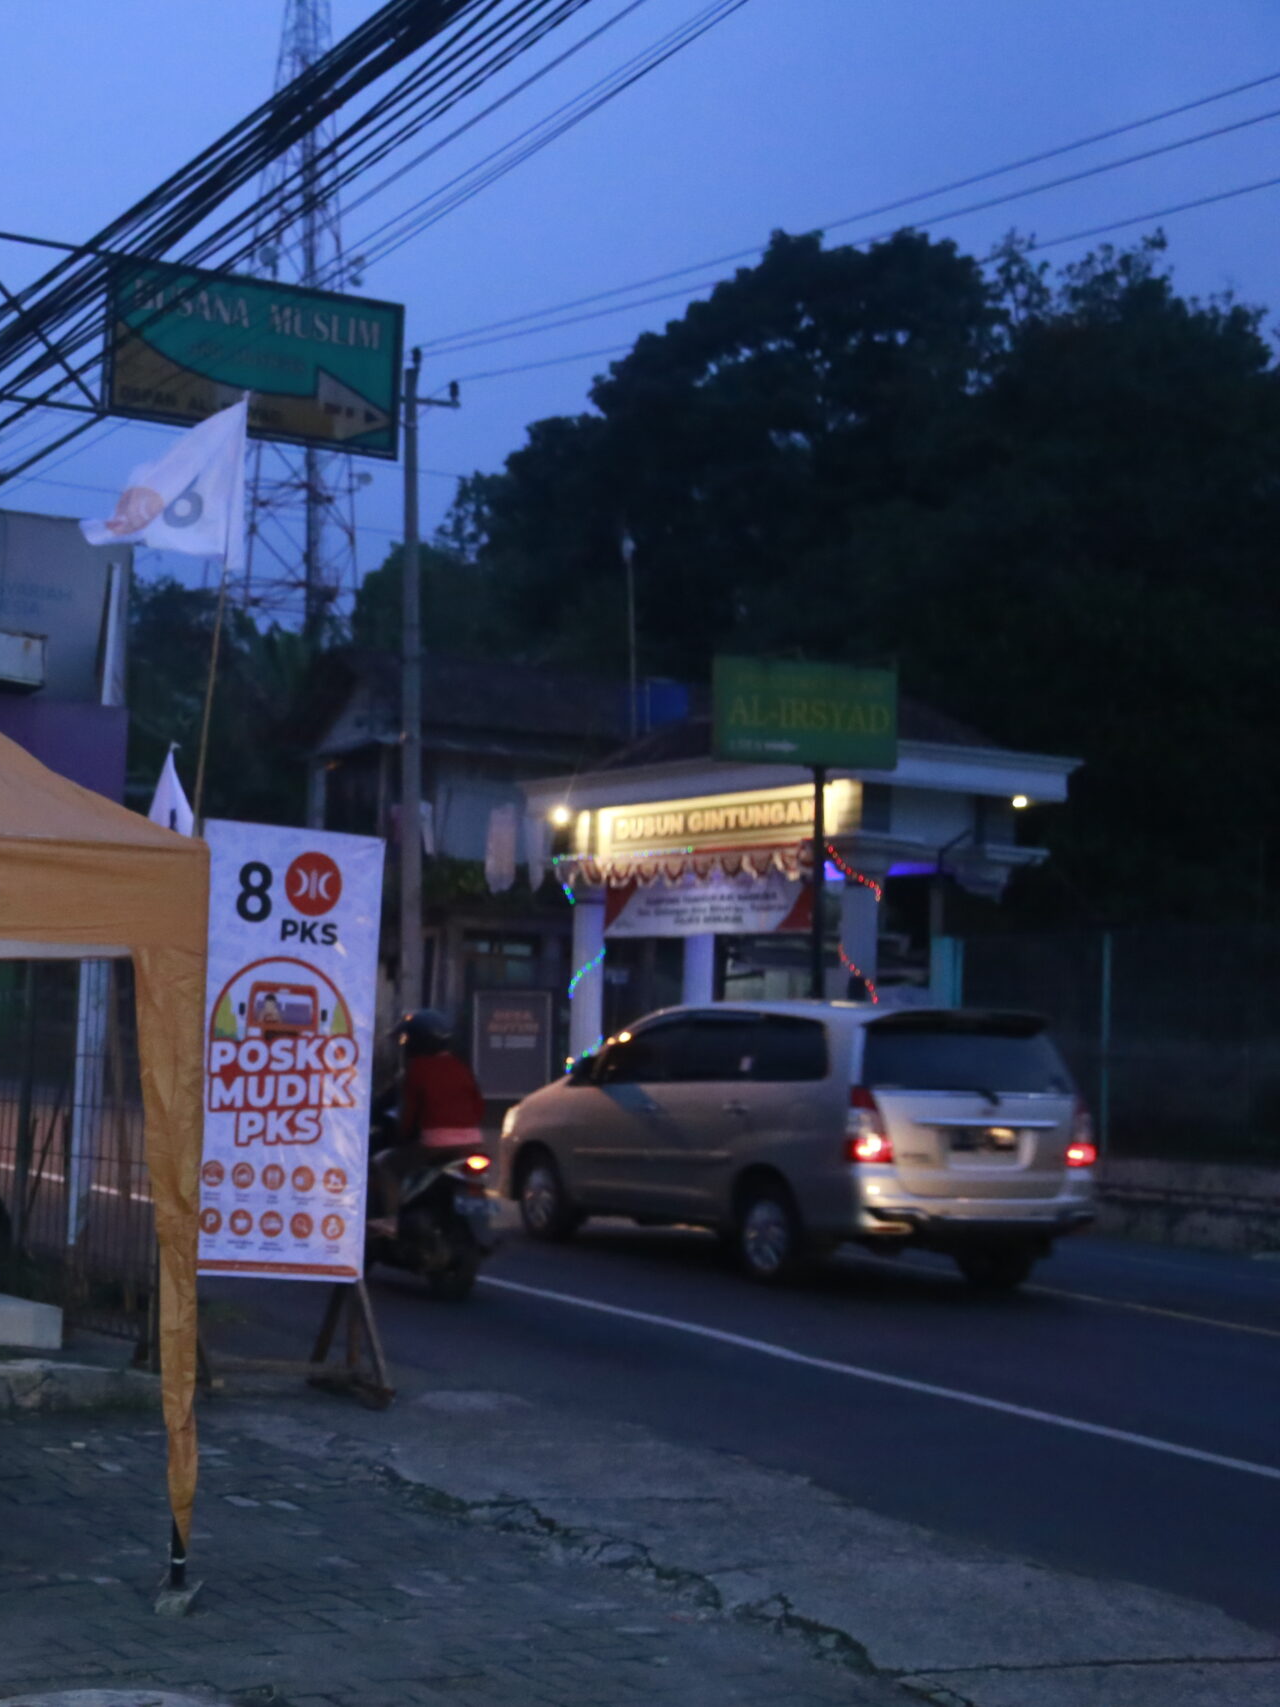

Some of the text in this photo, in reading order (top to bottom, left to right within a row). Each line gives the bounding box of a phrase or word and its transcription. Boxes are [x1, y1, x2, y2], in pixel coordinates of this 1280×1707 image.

[270, 304, 381, 350] MUSLIM
[615, 813, 683, 841] DUSUN
[236, 861, 273, 923] 8
[280, 919, 339, 946] PKS
[209, 1036, 357, 1074] POSKO
[209, 1073, 356, 1110] MUDIK
[236, 1109, 322, 1146] PKS
